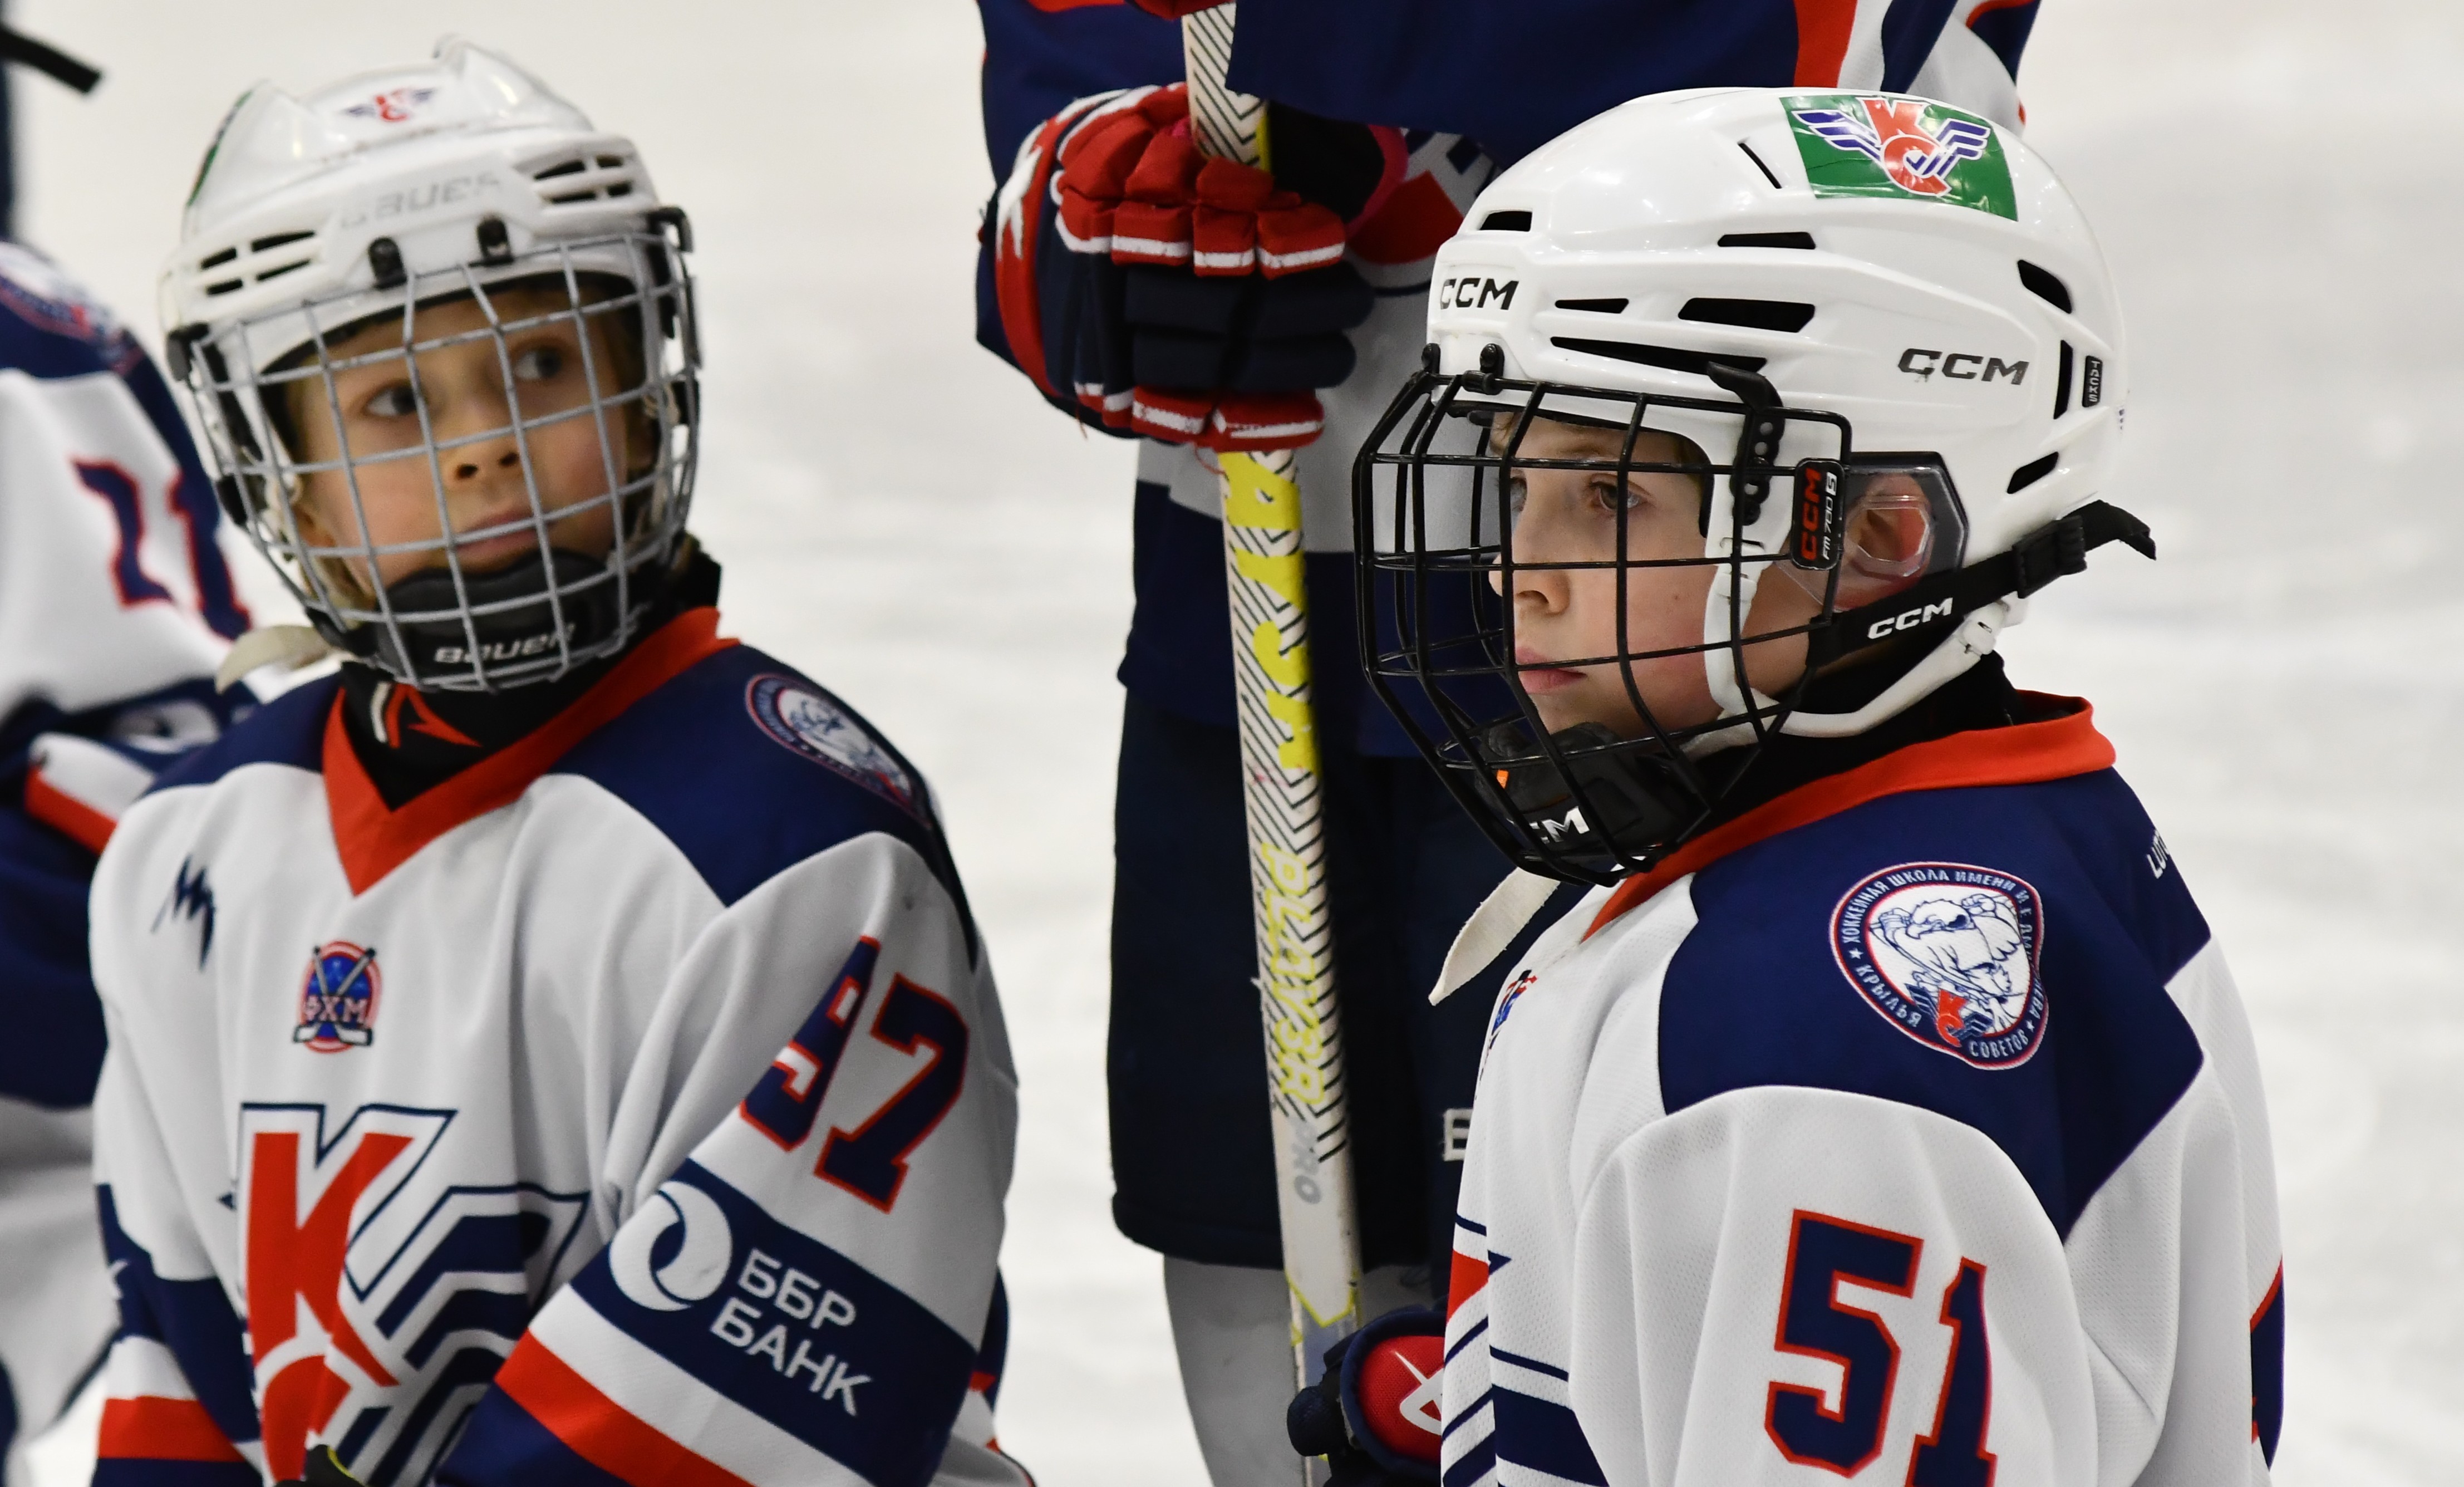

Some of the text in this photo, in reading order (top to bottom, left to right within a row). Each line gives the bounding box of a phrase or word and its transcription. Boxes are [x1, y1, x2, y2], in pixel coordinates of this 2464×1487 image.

[1440, 277, 1519, 311] CCM
[1898, 348, 2030, 386] CCM
[2088, 360, 2101, 403] TACKS
[1801, 467, 1822, 561] CCM
[1823, 536, 1832, 560] FM
[1867, 597, 1954, 639] CCM
[1887, 869, 1950, 887] ШКОЛА
[1955, 871, 2017, 891] ИМЕНИ
[1855, 964, 2029, 1058] КРЫЛЬЯ СОВЕТОВ
[739, 935, 970, 1214] 97
[737, 1248, 857, 1330] ББР
[710, 1297, 873, 1416] БАНК
[1764, 1209, 1998, 1487] 51
